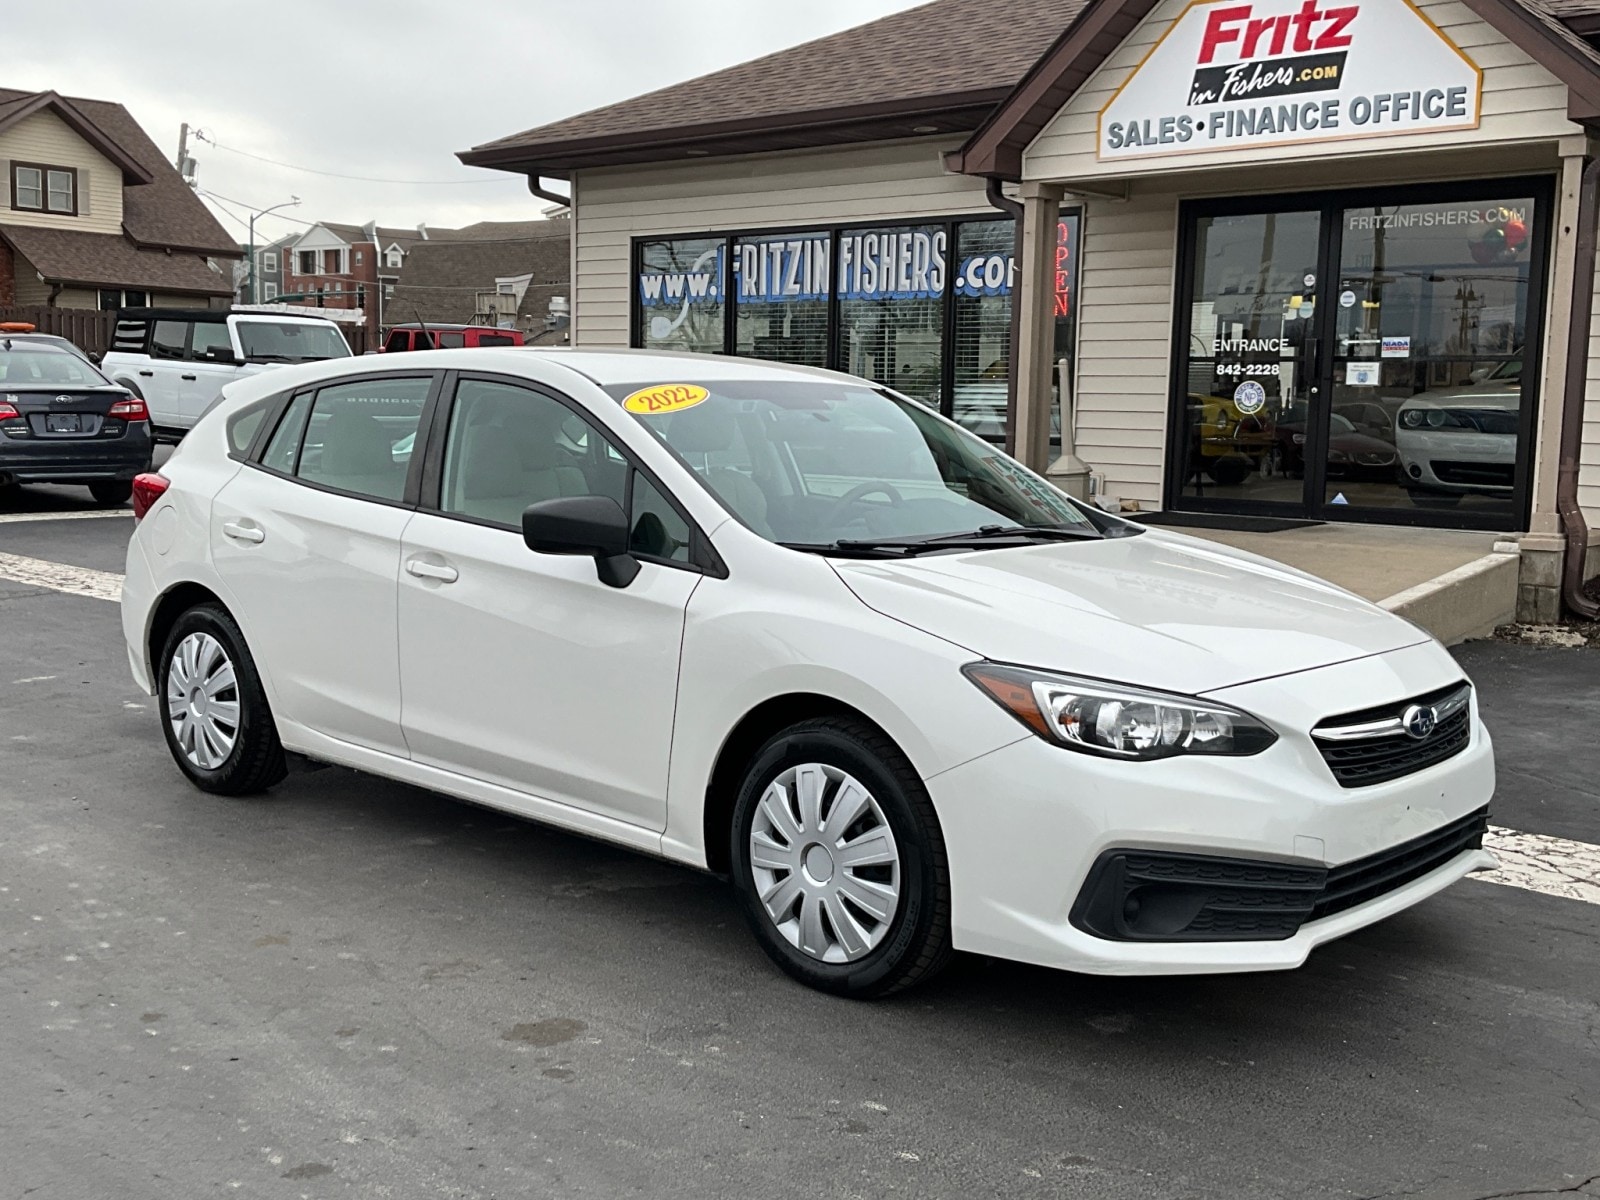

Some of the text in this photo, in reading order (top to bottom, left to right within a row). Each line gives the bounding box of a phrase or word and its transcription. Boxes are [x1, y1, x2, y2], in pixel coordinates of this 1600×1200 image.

[1197, 0, 1359, 64] Fritz
[1191, 82, 1216, 106] in
[1348, 86, 1467, 126] OFFICE
[1349, 207, 1526, 230] FRITZINFISHERS.COM
[1212, 338, 1289, 352] ENTRANCE
[1216, 364, 1280, 375] 842-2228
[638, 386, 698, 411] 2022
